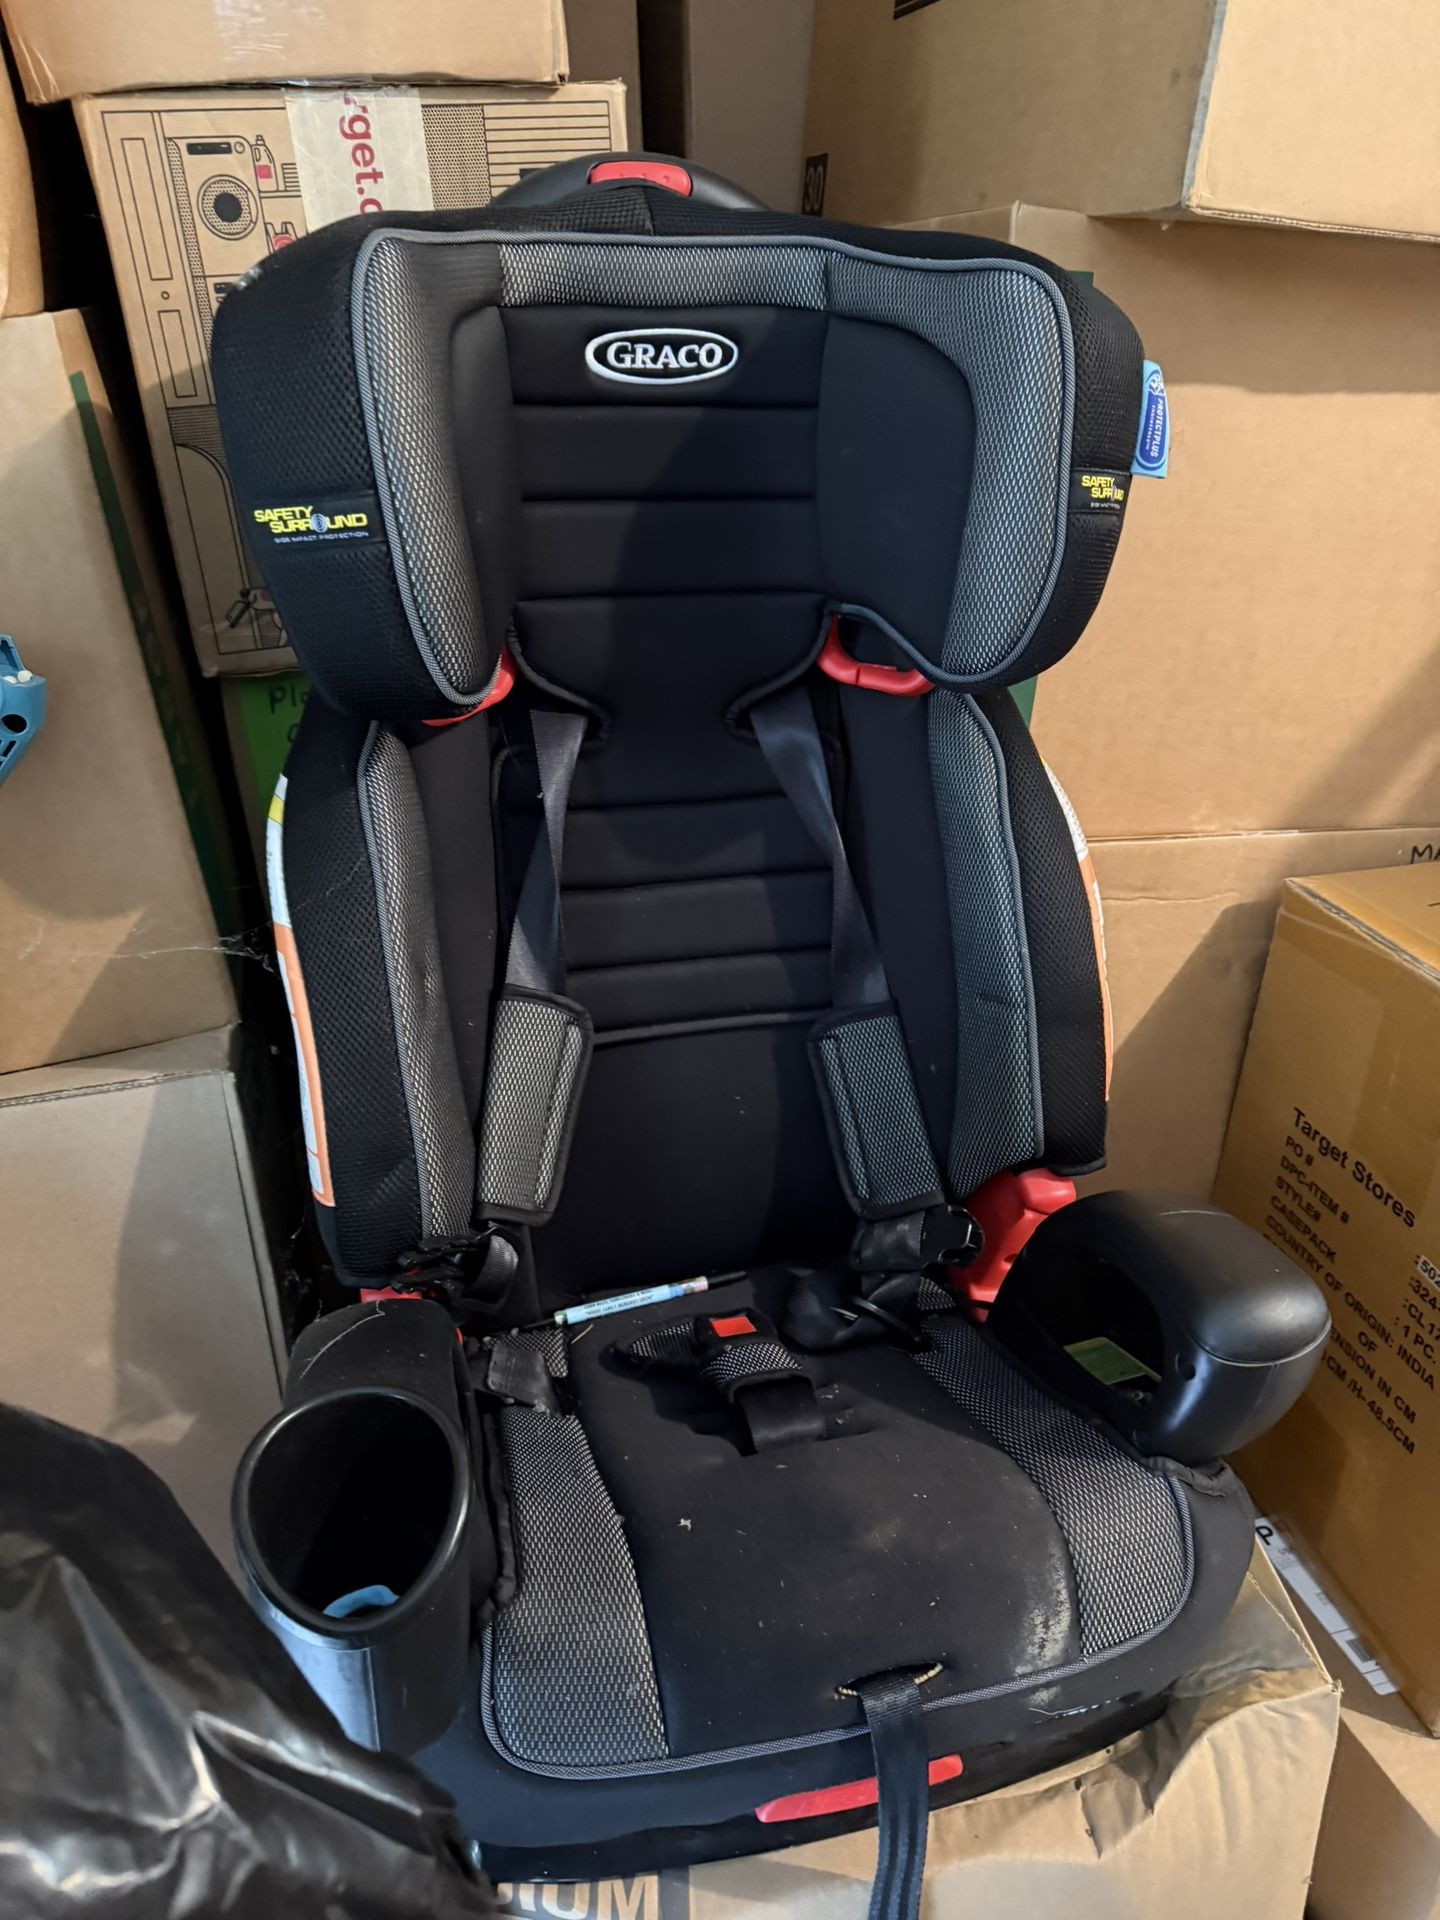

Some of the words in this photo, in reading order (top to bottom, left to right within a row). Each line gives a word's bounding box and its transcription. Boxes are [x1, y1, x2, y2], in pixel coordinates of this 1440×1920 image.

[606, 341, 723, 369] GRACO
[1150, 398, 1164, 458] PROTECTPLUS
[1082, 475, 1115, 487] SAFETY
[254, 506, 313, 522] SAFETY
[1286, 1135, 1304, 1158] PO
[1294, 1106, 1349, 1169] Target
[1352, 1160, 1416, 1228] Stores
[1270, 1195, 1337, 1264] CASEPACK
[1266, 1214, 1322, 1274] COUNTRY
[1323, 1271, 1343, 1292] OF
[1344, 1291, 1394, 1348] ORIGIN:
[1396, 1344, 1435, 1391] INDIA
[1358, 1331, 1379, 1353] OF
[1376, 1376, 1393, 1398] IN
[1393, 1394, 1417, 1424] CM
